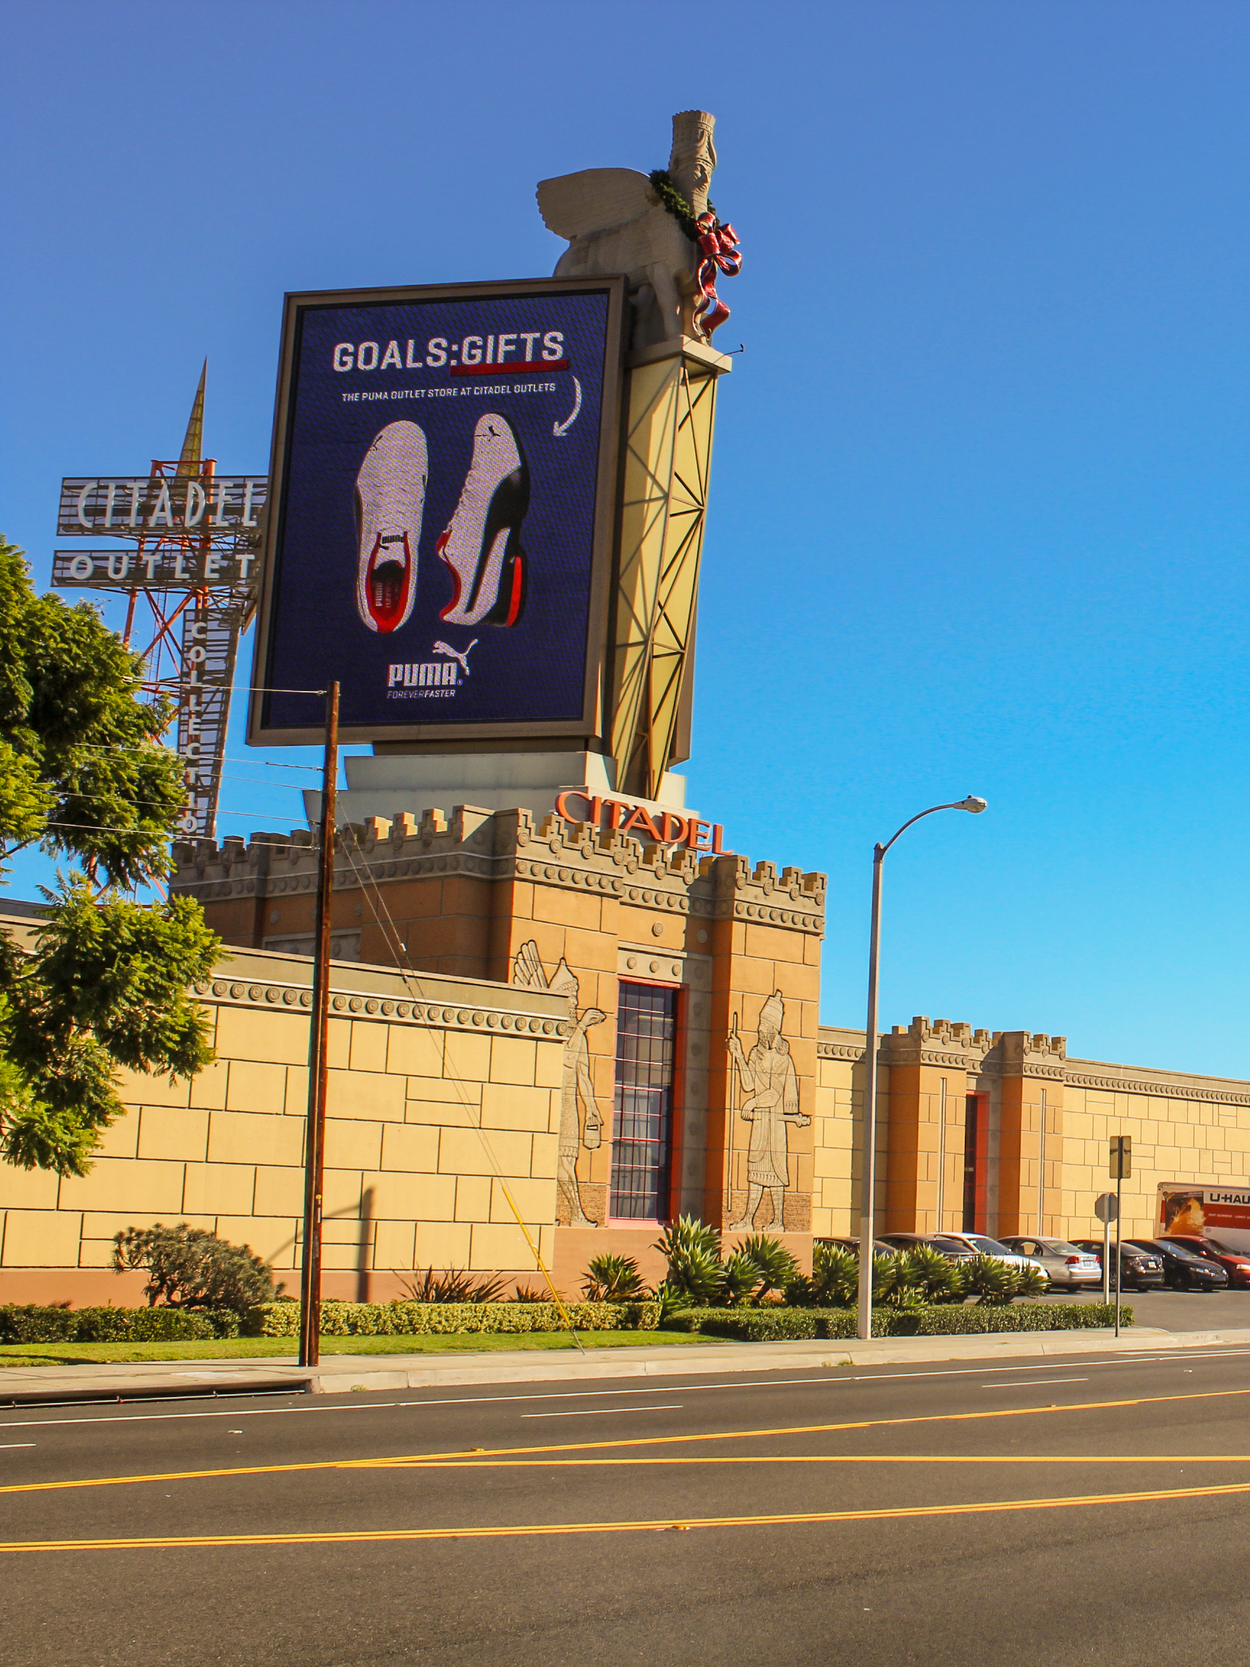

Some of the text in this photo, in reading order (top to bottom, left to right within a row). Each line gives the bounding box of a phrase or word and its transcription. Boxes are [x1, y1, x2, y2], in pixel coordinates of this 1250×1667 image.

[333, 331, 564, 373] GOALS:GIFTS
[342, 382, 556, 403] THE PUMA OUTLET STORE AT CITADEL OUTLETS
[77, 480, 258, 529] CITADEL
[387, 662, 458, 687] PUMA
[182, 622, 208, 840] COLLECTIO
[555, 790, 735, 857] CITADEL
